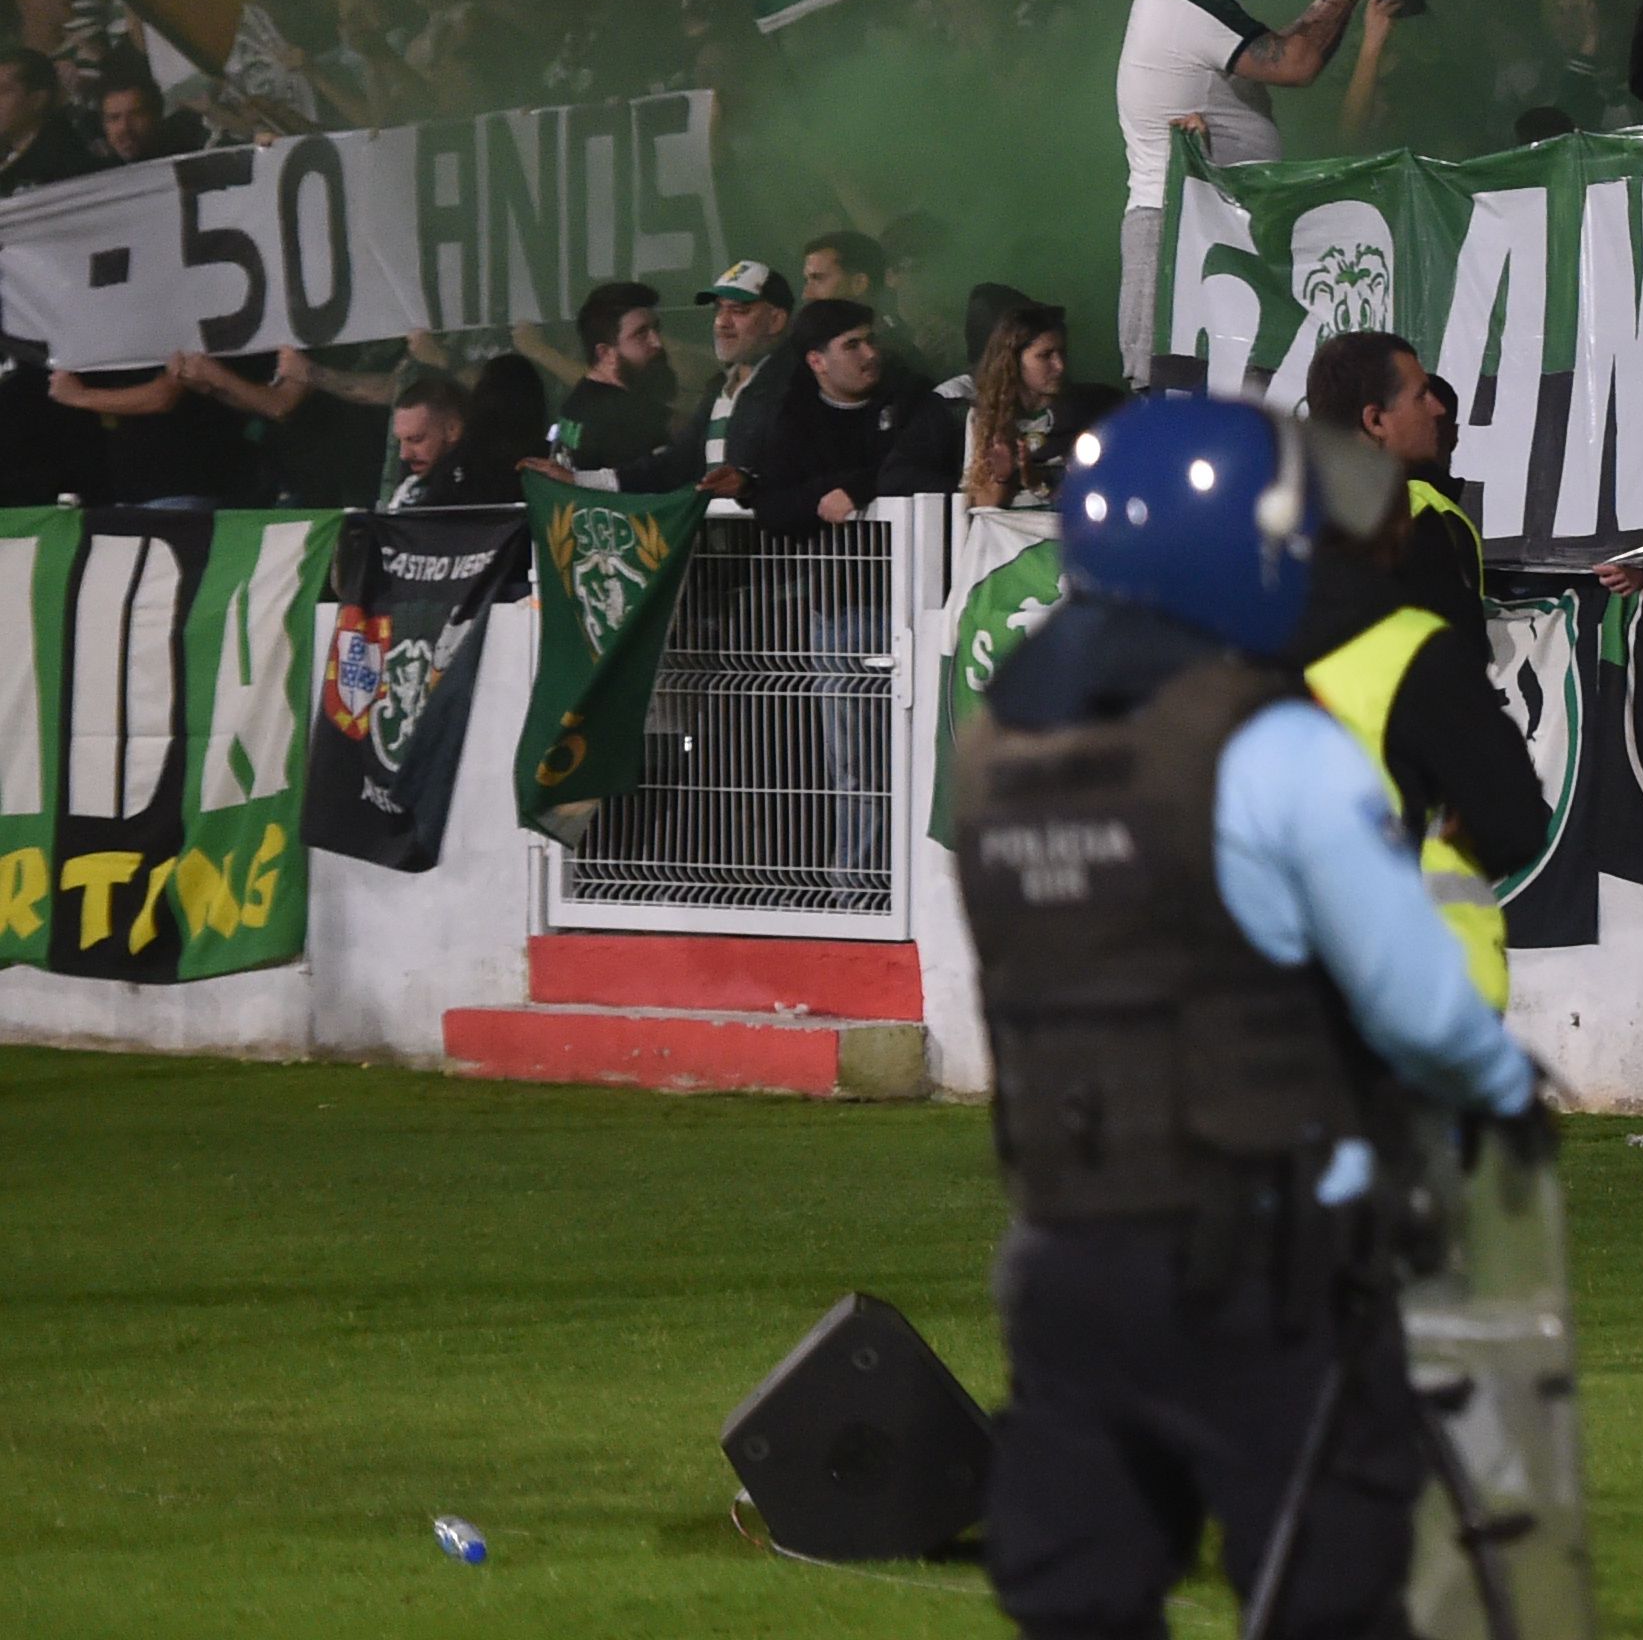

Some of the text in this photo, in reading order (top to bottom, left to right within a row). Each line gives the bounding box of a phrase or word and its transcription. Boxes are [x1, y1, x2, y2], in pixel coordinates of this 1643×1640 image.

[173, 135, 351, 354] 50
[415, 93, 716, 332] ANOS
[572, 507, 635, 557] SCP
